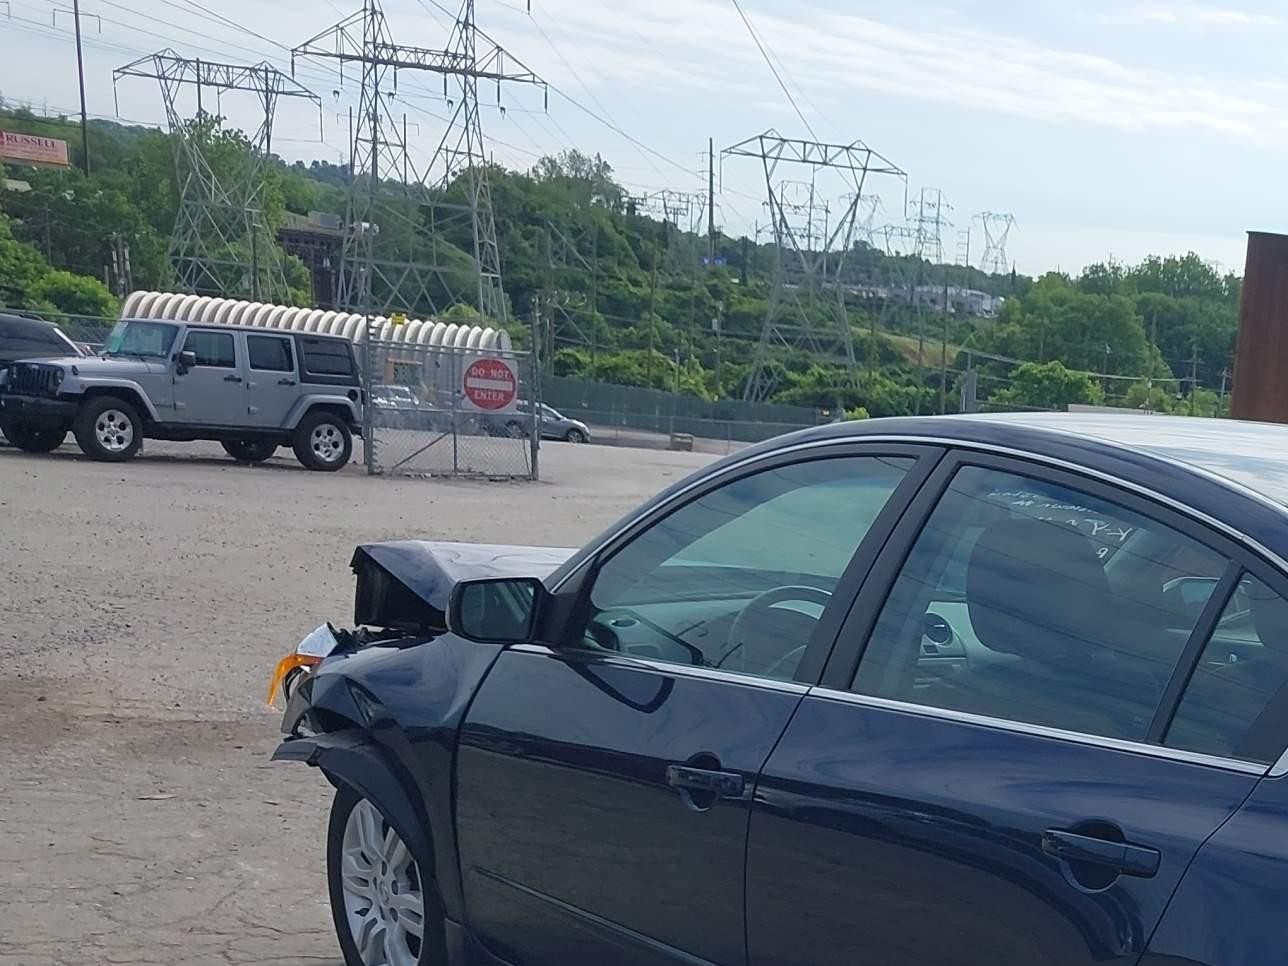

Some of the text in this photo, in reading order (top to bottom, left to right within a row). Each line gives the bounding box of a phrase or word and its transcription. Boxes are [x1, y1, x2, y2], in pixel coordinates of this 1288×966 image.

[6, 134, 55, 148] RUSSELL
[471, 366, 510, 378] DO NOT
[474, 391, 505, 401] ENTER
